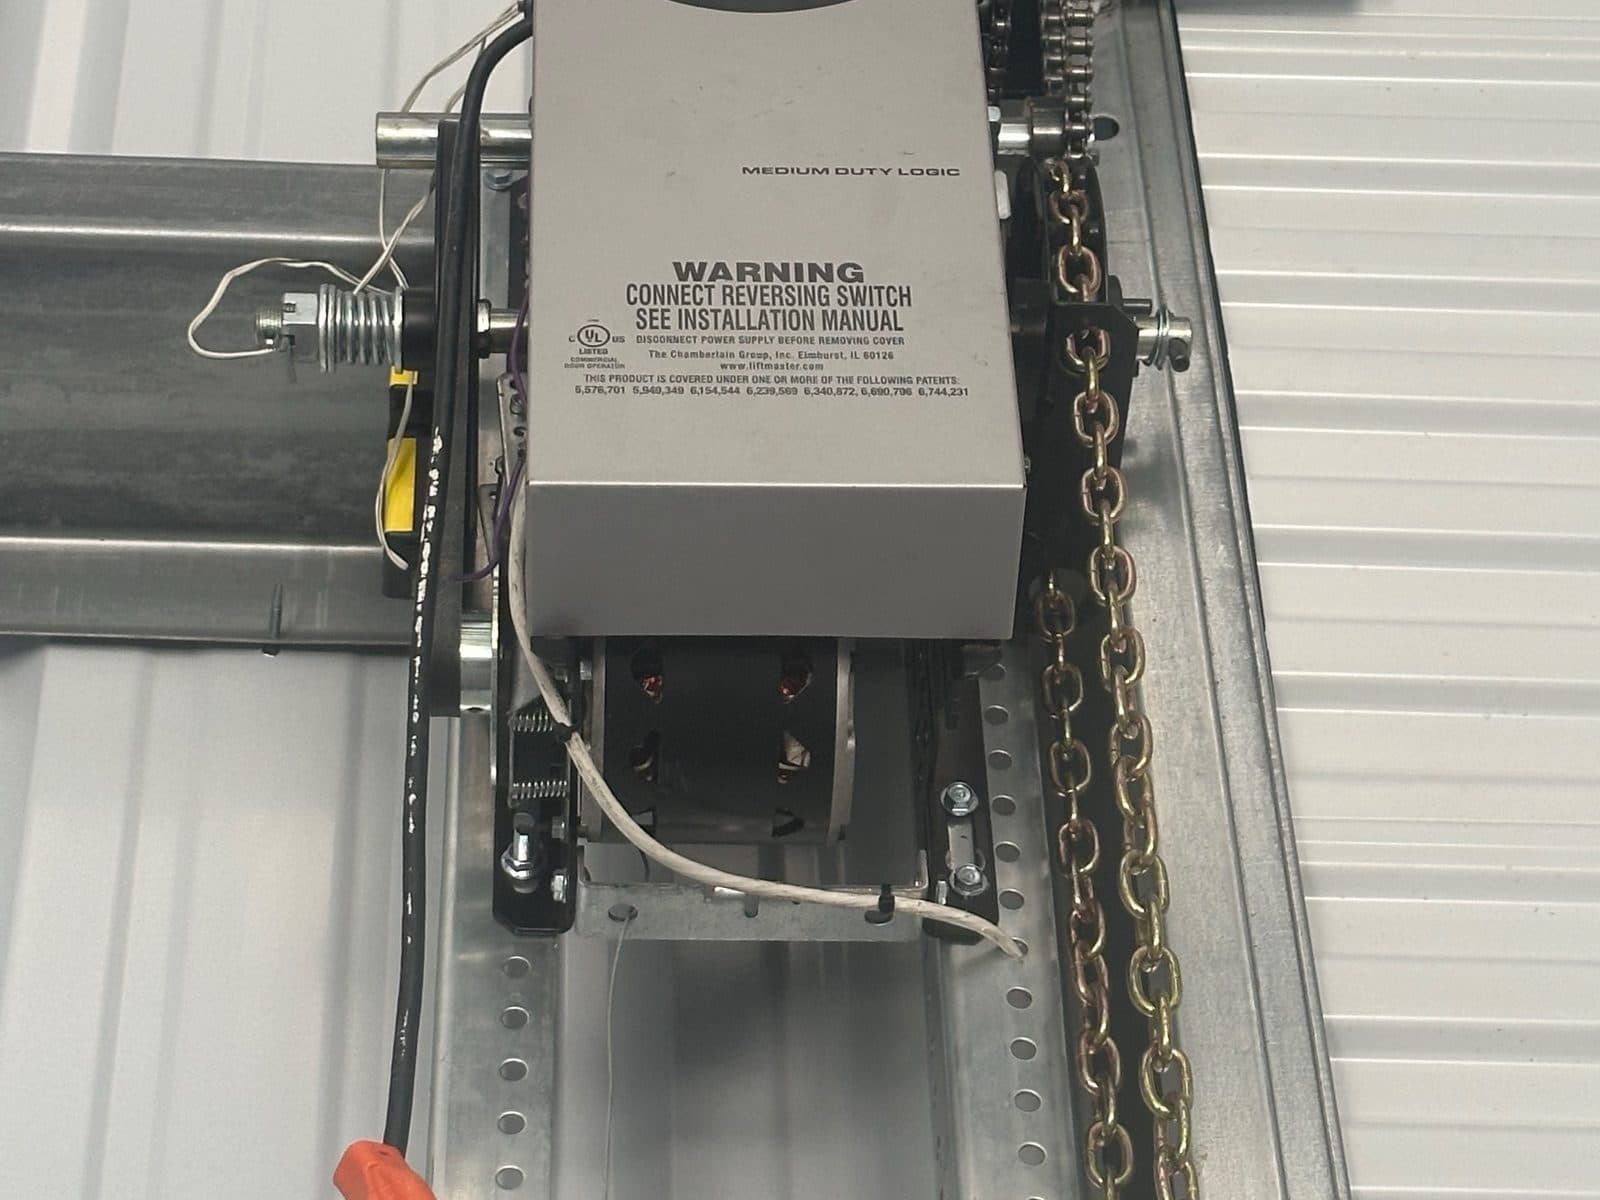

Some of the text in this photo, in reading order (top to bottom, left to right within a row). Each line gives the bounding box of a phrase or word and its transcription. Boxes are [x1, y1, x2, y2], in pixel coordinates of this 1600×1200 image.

[742, 166, 961, 176] MEDIUM DUTY LOGIC
[672, 261, 865, 283] WARNING
[626, 284, 912, 307] CONNECT REVERSING SWITCH
[636, 308, 904, 331] SEE INSTALLATION MANUAL
[636, 335, 905, 345] DISCONNECT POWER SUPPLY BEFORE REMOVING COVER
[649, 350, 667, 359] The
[671, 350, 735, 359] Chamberlain
[739, 350, 772, 360] Group,
[850, 351, 860, 359] IL
[863, 351, 894, 359] 60126
[720, 362, 824, 370] www.liftmaster.com
[585, 374, 606, 383] THIS
[609, 374, 654, 383] PRODUCT
[657, 374, 666, 383] IS
[669, 375, 713, 383] COVERED
[716, 375, 749, 384] UNDER
[752, 375, 771, 384] ONE
[774, 375, 787, 384] OR
[791, 375, 818, 384] MORE
[821, 376, 833, 384] OF
[836, 376, 854, 384] THE
[857, 376, 913, 385] FOLLOWING
